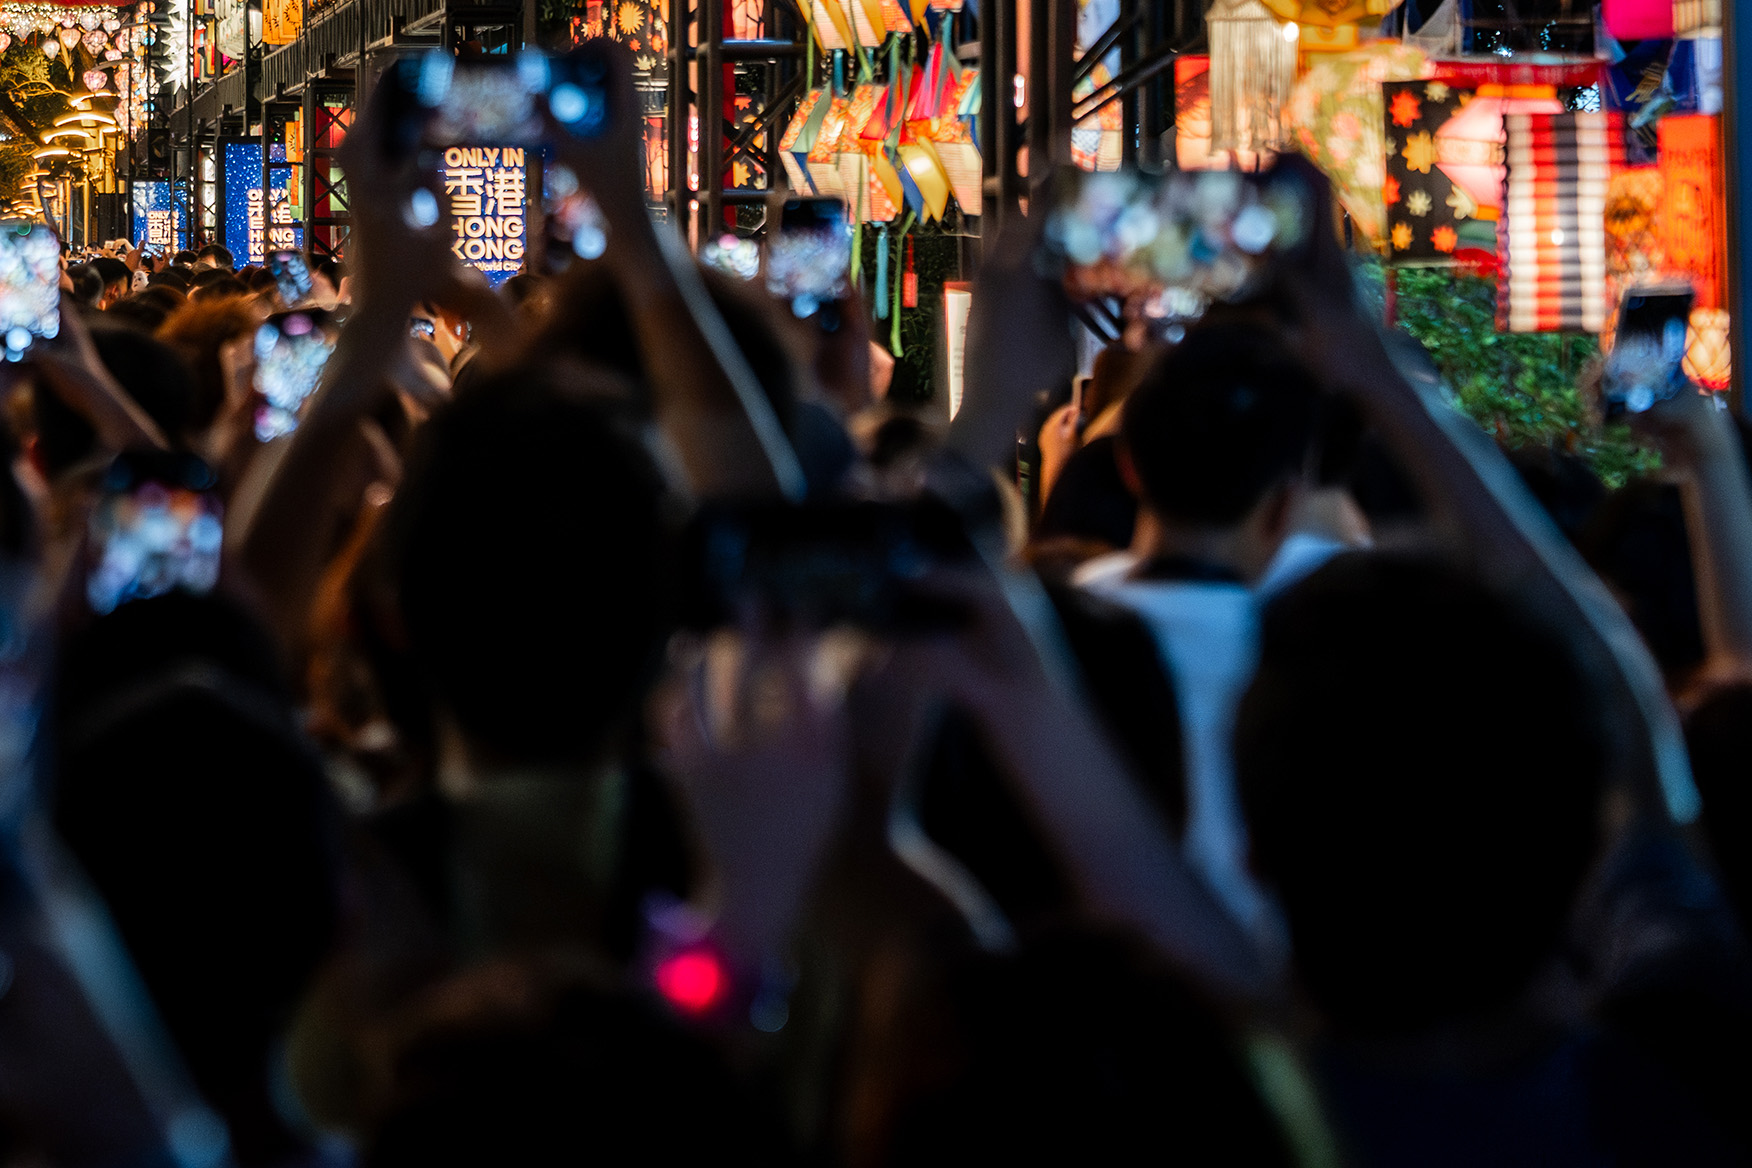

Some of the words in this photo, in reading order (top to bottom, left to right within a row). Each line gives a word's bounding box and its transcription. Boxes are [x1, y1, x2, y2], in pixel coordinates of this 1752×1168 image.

[445, 147, 499, 168] ONLY
[502, 147, 525, 168] IN
[445, 167, 525, 216] 香港
